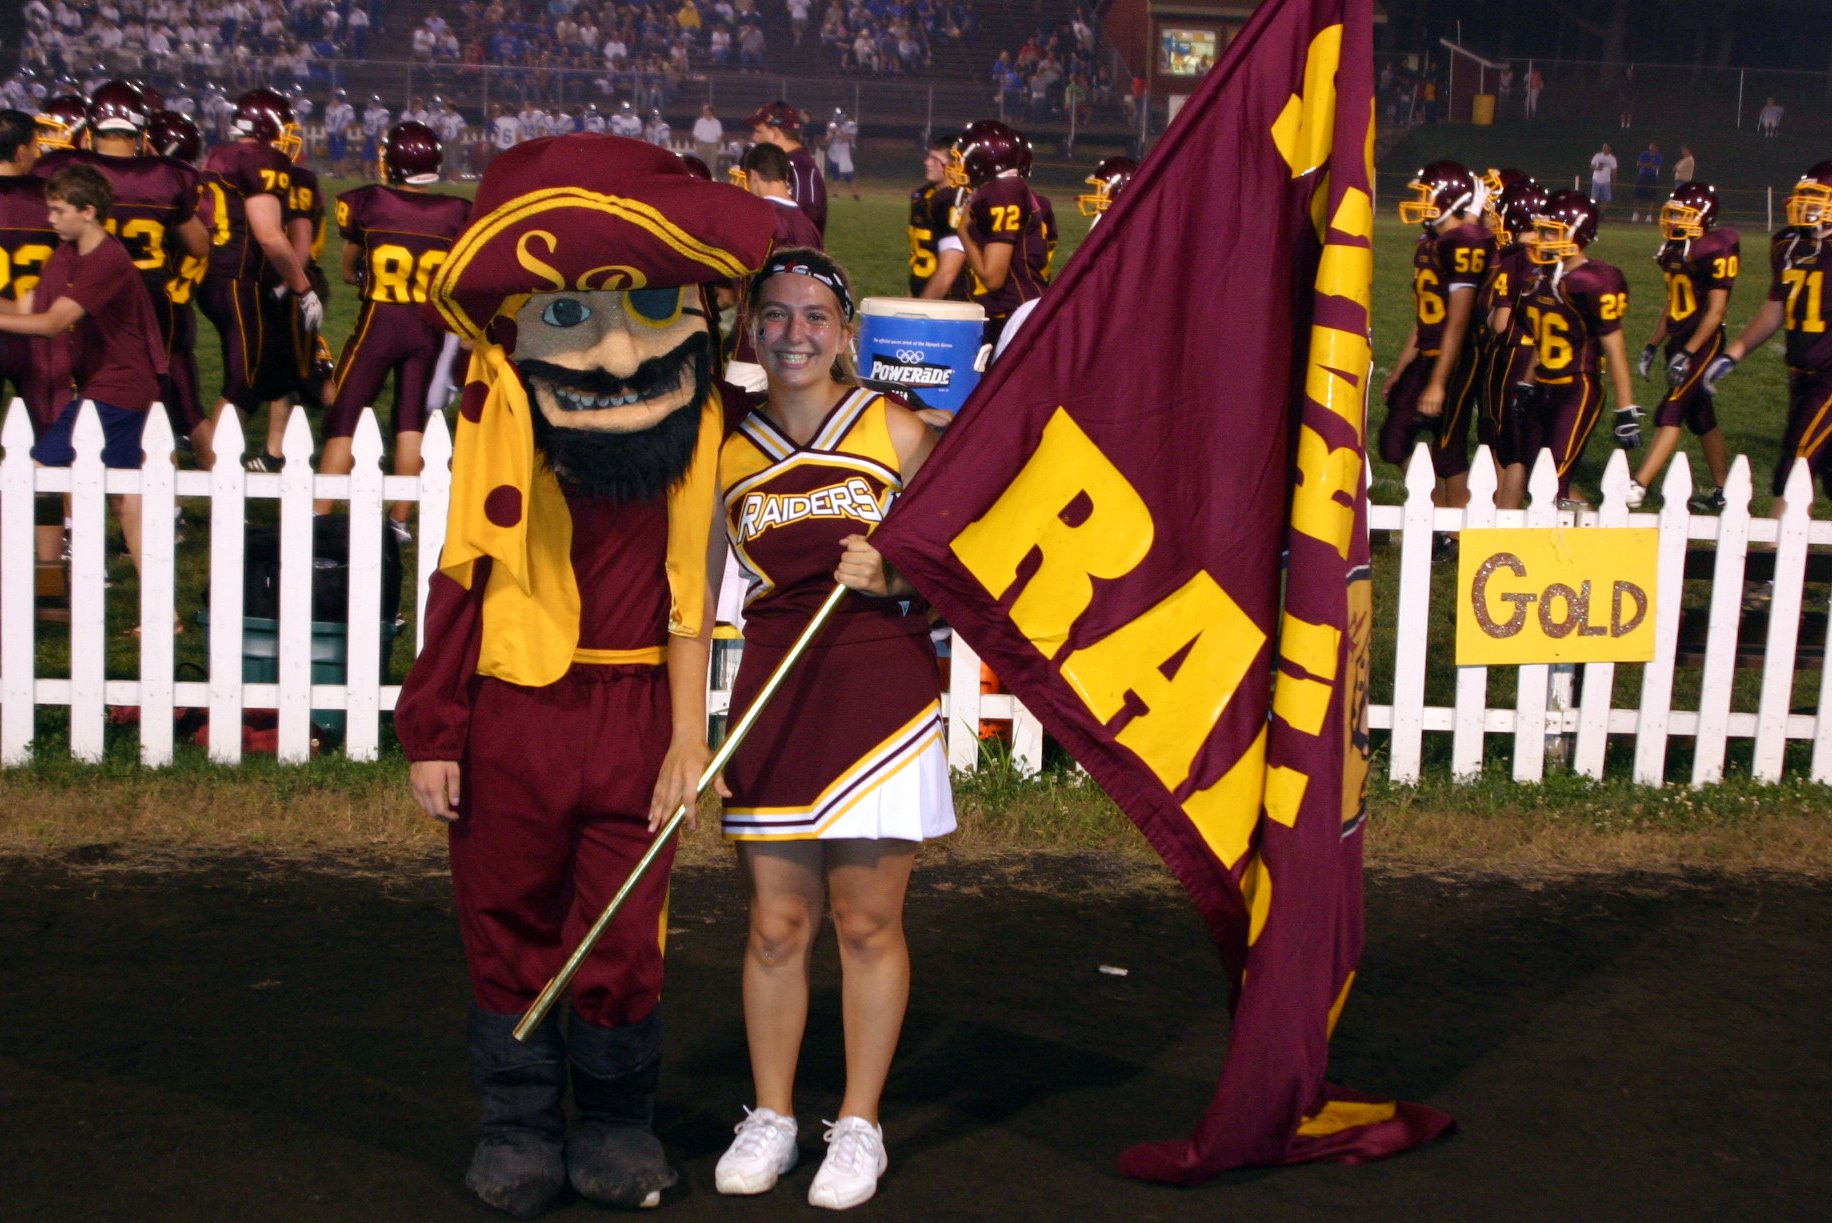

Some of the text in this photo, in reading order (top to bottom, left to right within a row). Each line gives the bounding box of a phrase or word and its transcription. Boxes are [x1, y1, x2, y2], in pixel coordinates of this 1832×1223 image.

[990, 204, 1020, 231] 72
[1454, 247, 1486, 273] 56
[1712, 256, 1739, 279] 30
[1782, 269, 1826, 333] 71
[736, 474, 884, 545] RAIDERS
[1471, 552, 1648, 639] GOLD
